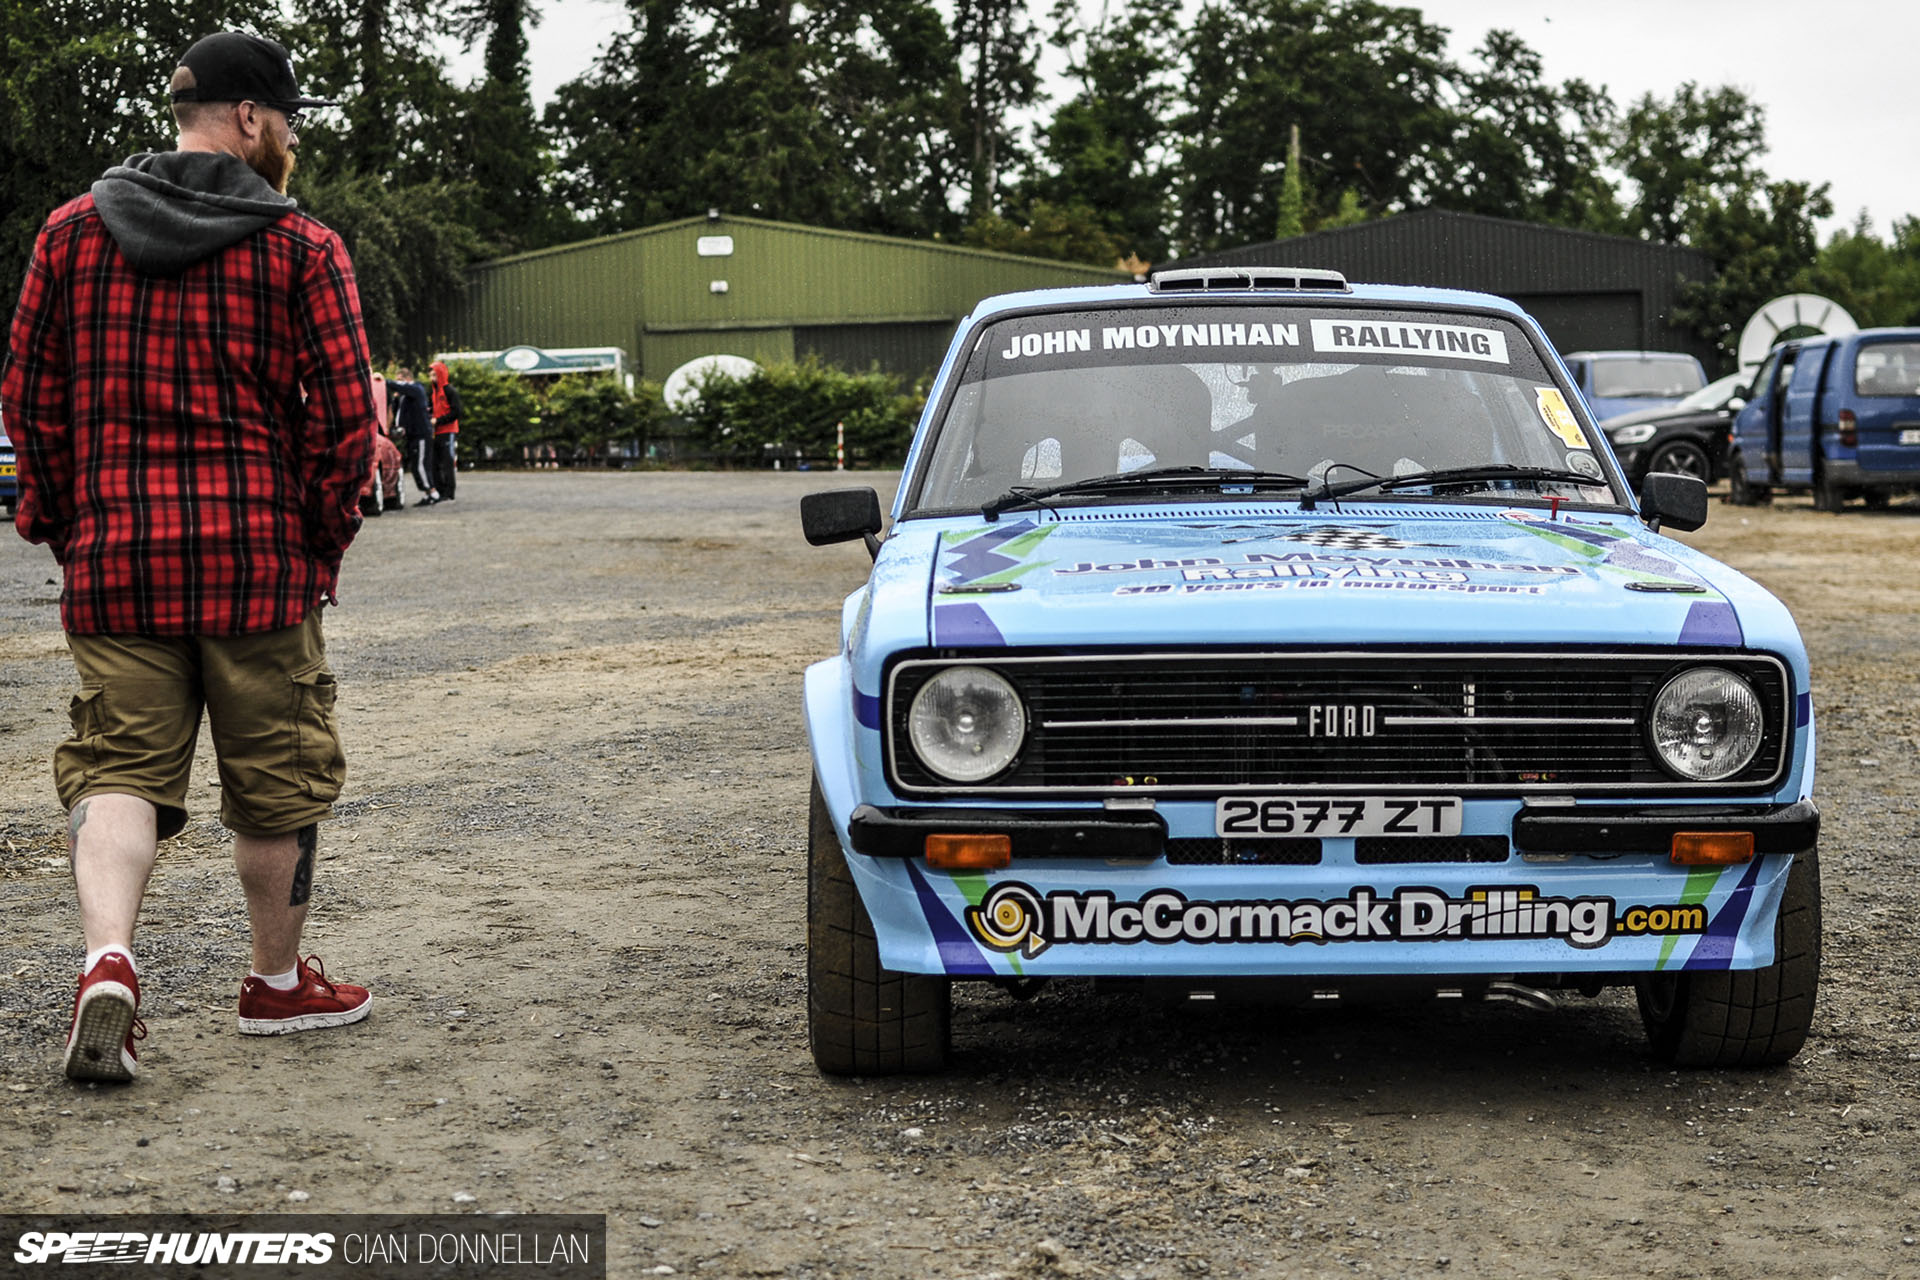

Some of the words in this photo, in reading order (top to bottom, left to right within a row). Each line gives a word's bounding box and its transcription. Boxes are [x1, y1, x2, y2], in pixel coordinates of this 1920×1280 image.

[1002, 329, 1091, 360] JOHN
[1102, 323, 1300, 350] MOYNIHAN
[1333, 325, 1492, 356] RALLYING
[1054, 558, 1222, 574] John
[1247, 553, 1580, 574] Moynihan
[1181, 563, 1470, 583] Rallying
[1183, 582, 1286, 594] years
[1298, 578, 1329, 588] in
[1343, 579, 1541, 594] motorsport
[1309, 705, 1375, 737] FORD
[1223, 800, 1366, 833] 2677
[1383, 800, 1456, 833] ZT
